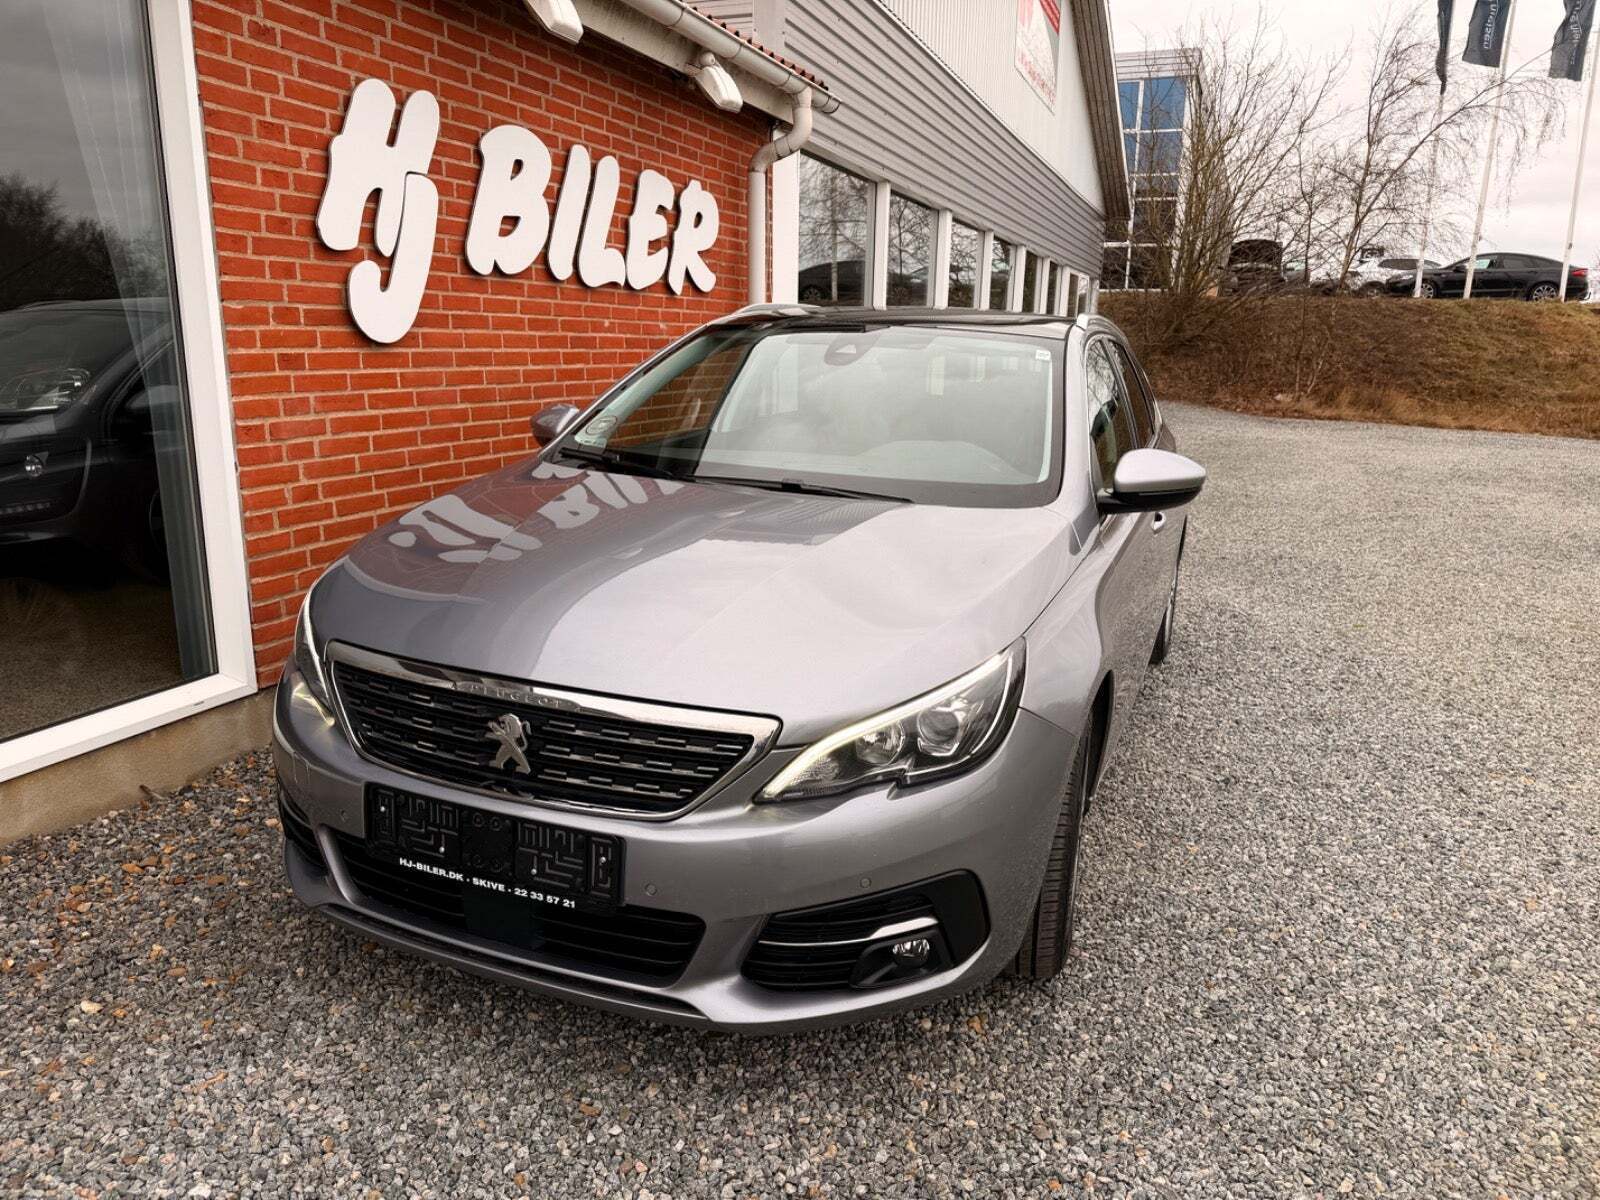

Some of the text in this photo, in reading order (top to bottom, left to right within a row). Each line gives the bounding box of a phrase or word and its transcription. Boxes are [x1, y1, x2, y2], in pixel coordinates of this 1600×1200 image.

[316, 78, 720, 344] HJ BILER
[469, 684, 563, 708] PEUGEOT
[399, 857, 577, 909] HJ-BILER.DK SKIVE 22 33 57 21
